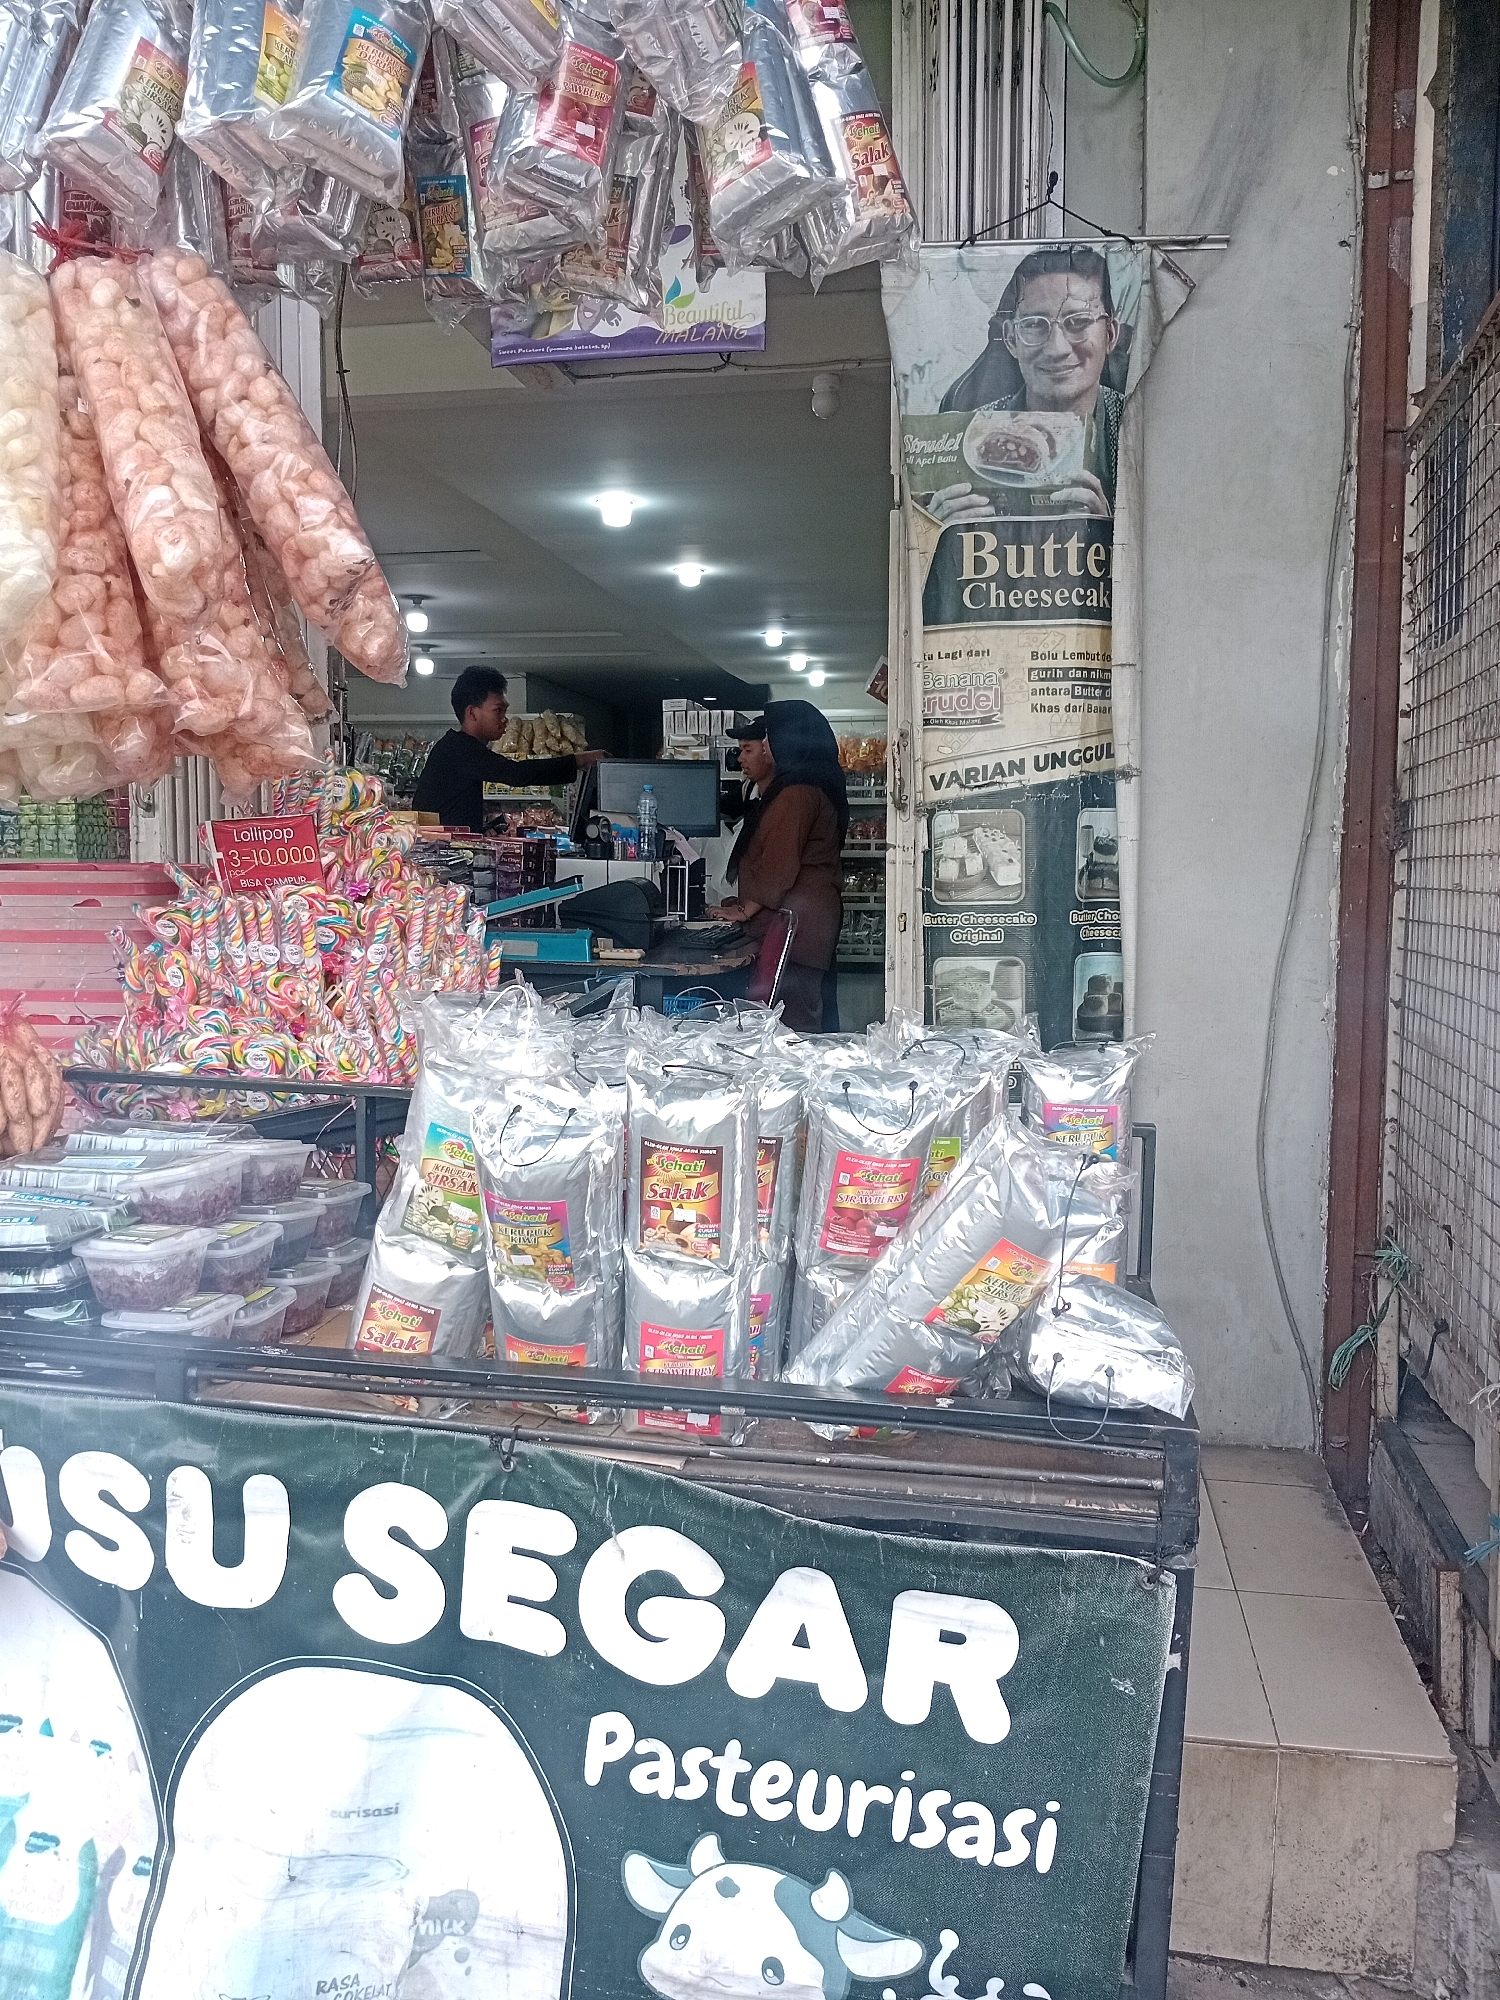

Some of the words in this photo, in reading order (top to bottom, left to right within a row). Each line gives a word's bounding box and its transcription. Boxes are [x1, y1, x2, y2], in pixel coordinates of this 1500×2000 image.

[141, 84, 175, 114] SIRSAK
[851, 141, 890, 169] Salak
[664, 299, 756, 326] Beautiful
[655, 326, 748, 345] MALANG
[903, 431, 964, 454] Strudel
[915, 454, 936, 468] Apel
[937, 454, 958, 464] Batu
[957, 531, 1114, 581] Butte
[937, 649, 963, 661] Lagi
[966, 648, 990, 658] dari
[1030, 650, 1058, 662] Bolu
[1062, 650, 1100, 662] Lembut
[923, 671, 999, 690] Banana
[1030, 669, 1063, 681] gurih
[1068, 668, 1088, 679] dan
[923, 686, 1001, 714] rudel
[1030, 687, 1071, 697] antara
[1074, 686, 1103, 697] Butter
[1030, 703, 1061, 714] Khas
[1064, 702, 1085, 713] dari
[929, 757, 1026, 791] VARIAN
[1033, 743, 1115, 773] UNGGUL
[233, 827, 294, 844] Lollipop
[240, 878, 261, 889] BISA
[264, 876, 307, 887] CAMPUR
[924, 914, 959, 925] Butter
[961, 914, 1035, 925] Cheesecake
[951, 930, 1002, 942] Original
[1070, 1115, 1105, 1125] Sehati
[1055, 1131, 1109, 1142] KERUPUK
[449, 1147, 475, 1164] Seha
[433, 1163, 476, 1180] KERUPUK
[659, 1159, 706, 1173] Sehati
[425, 1172, 479, 1194] SIRSAK
[864, 1172, 904, 1182] Sehati
[647, 1181, 714, 1201] Salak
[836, 1192, 909, 1205] STRAWBERRY
[498, 1225, 553, 1238] KERUPUK
[509, 1236, 538, 1245] KIWI
[379, 1305, 424, 1328] Sehati
[363, 1326, 425, 1352] Salak
[666, 1343, 707, 1355] Sehati
[332, 1481, 1021, 1745] SEGAR
[583, 1711, 1061, 1874] Pasteurisasi
[326, 1802, 400, 1819] eurisasi
[315, 1973, 361, 1996] RASA
